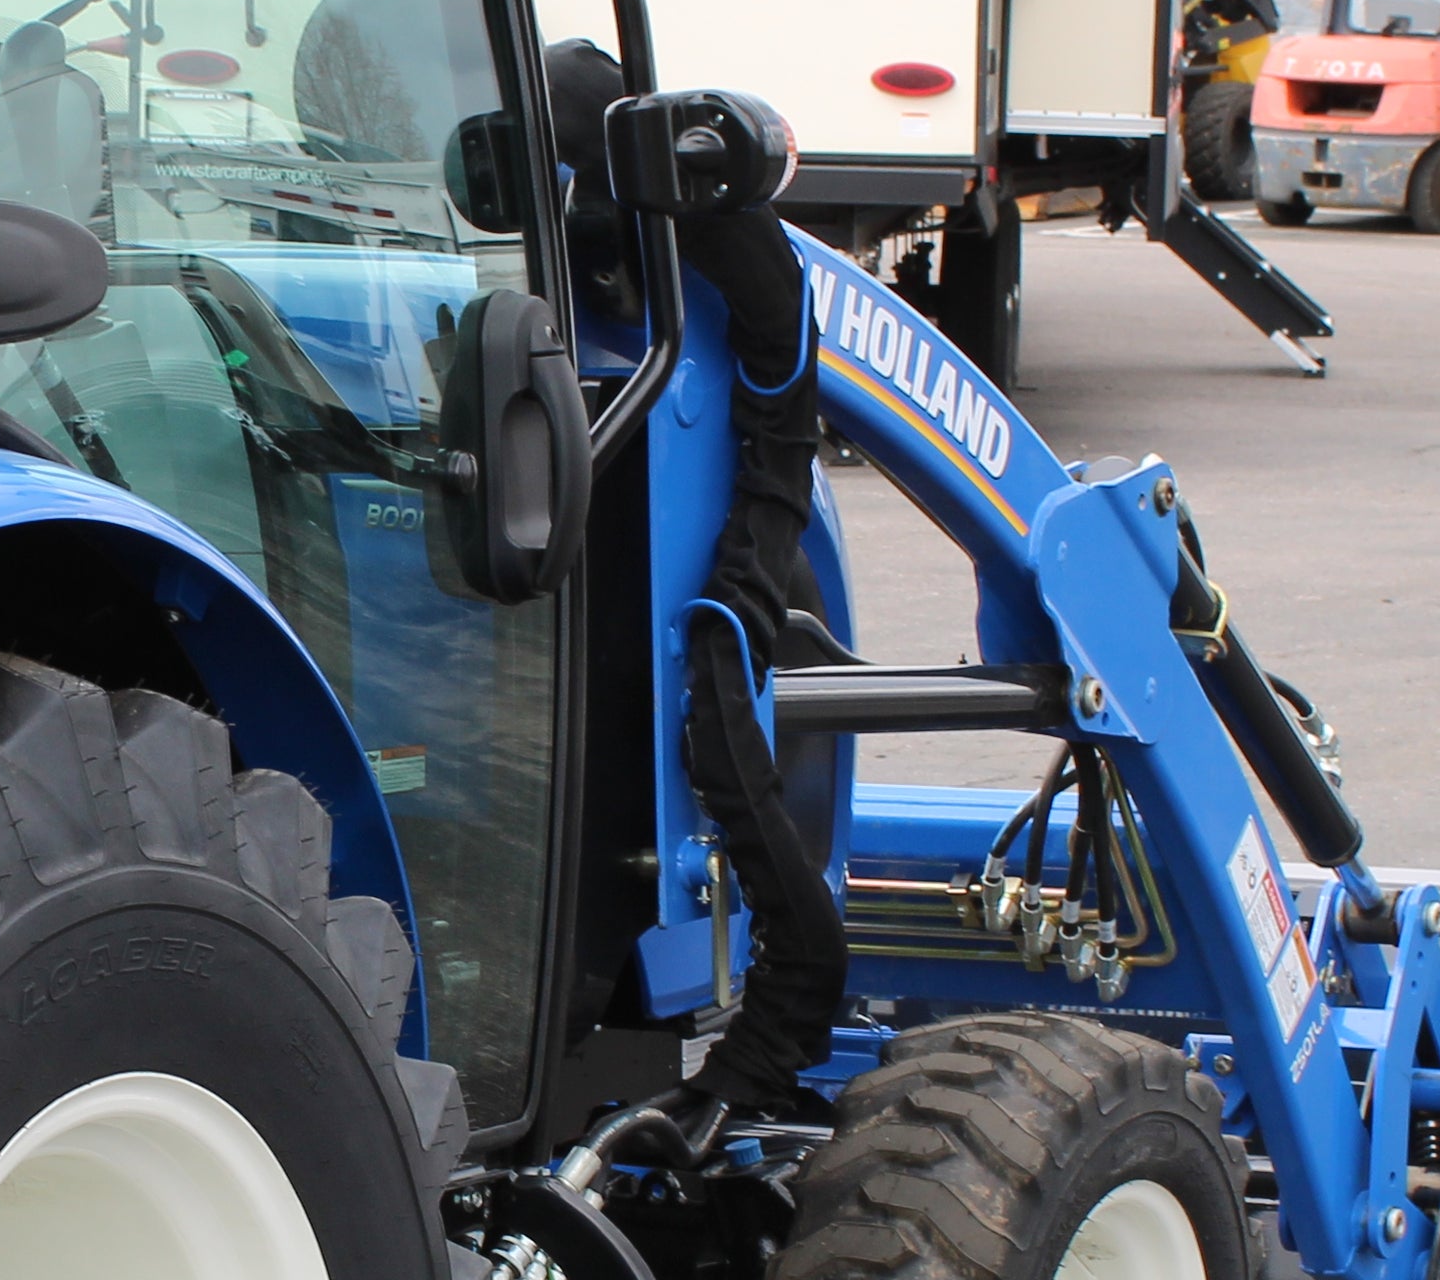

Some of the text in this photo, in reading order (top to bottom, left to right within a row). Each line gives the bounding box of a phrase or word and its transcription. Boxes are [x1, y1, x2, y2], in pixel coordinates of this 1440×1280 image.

[838, 282, 1012, 480] HOLLAND
[366, 503, 424, 532] BOO
[14, 935, 218, 1028] LOADER
